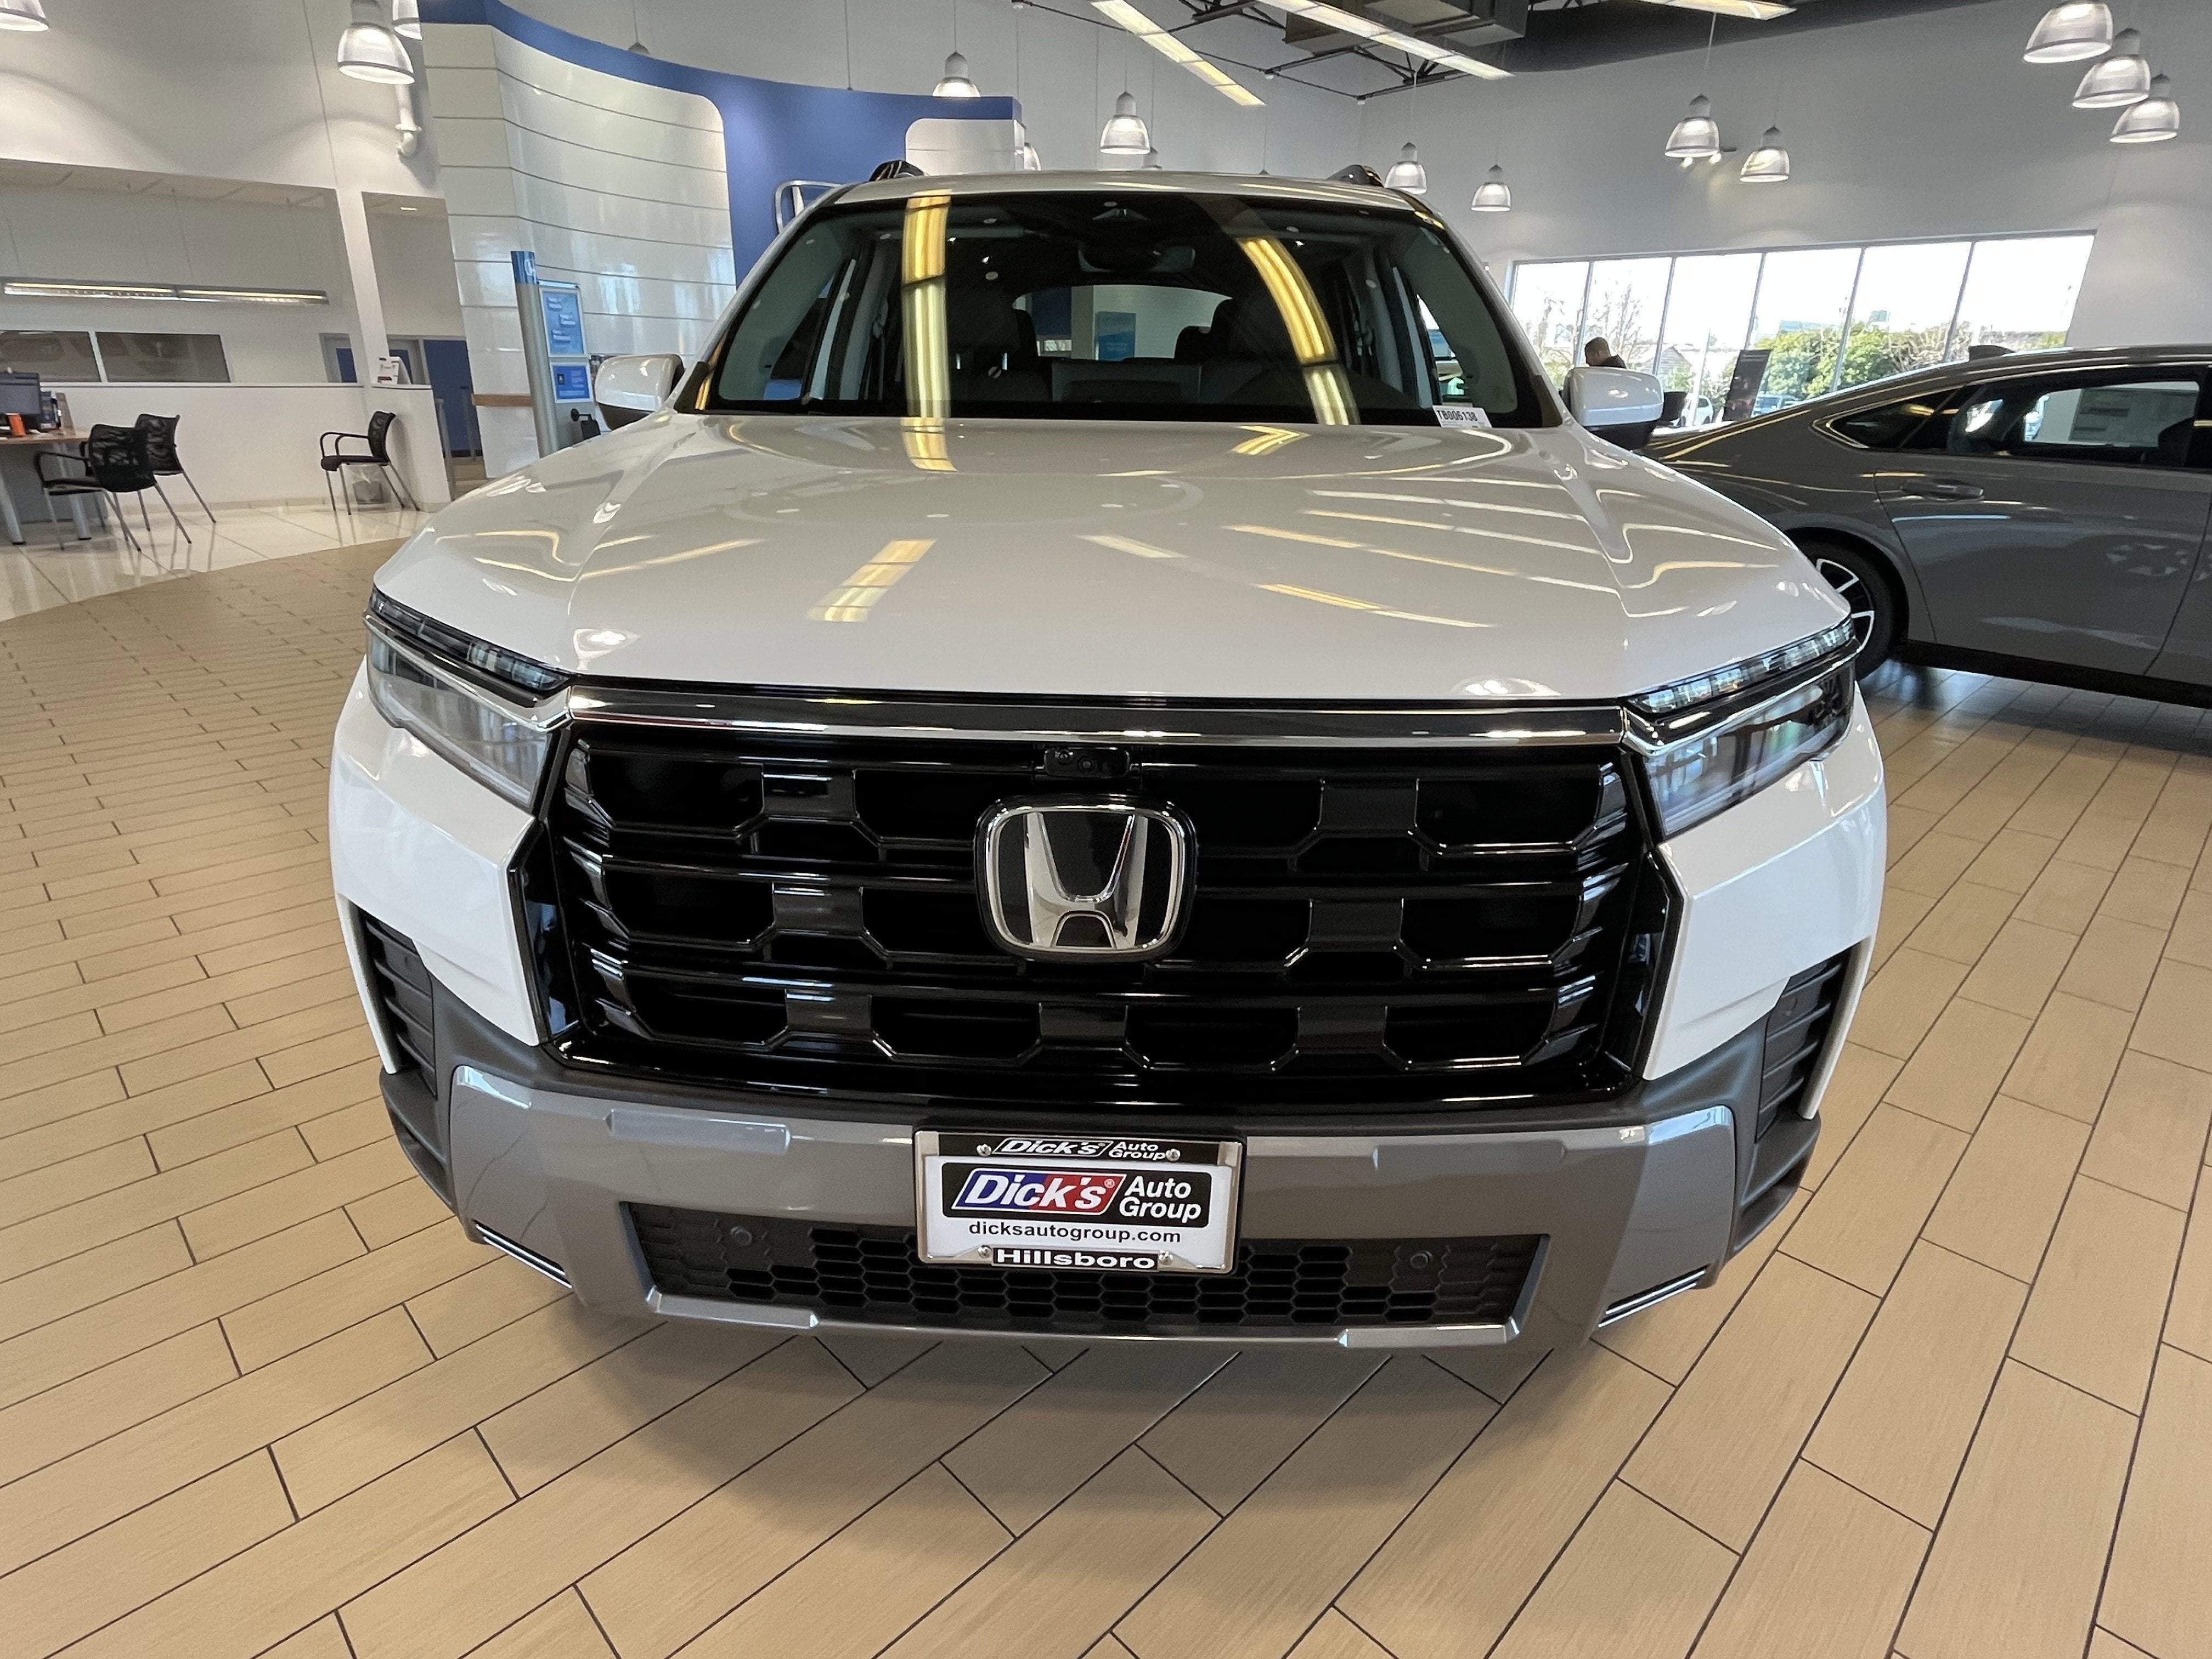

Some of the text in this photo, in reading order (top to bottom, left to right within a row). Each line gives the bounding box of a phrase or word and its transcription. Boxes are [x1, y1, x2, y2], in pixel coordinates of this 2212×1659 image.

[1108, 1149, 1166, 1161] Group
[1113, 1141, 1159, 1152] Auto
[1125, 1175, 1192, 1199] Auto
[1119, 1197, 1201, 1223] Group
[969, 1221, 1181, 1243] dicksautogroup.com
[996, 1249, 1155, 1269] Hillsboro
